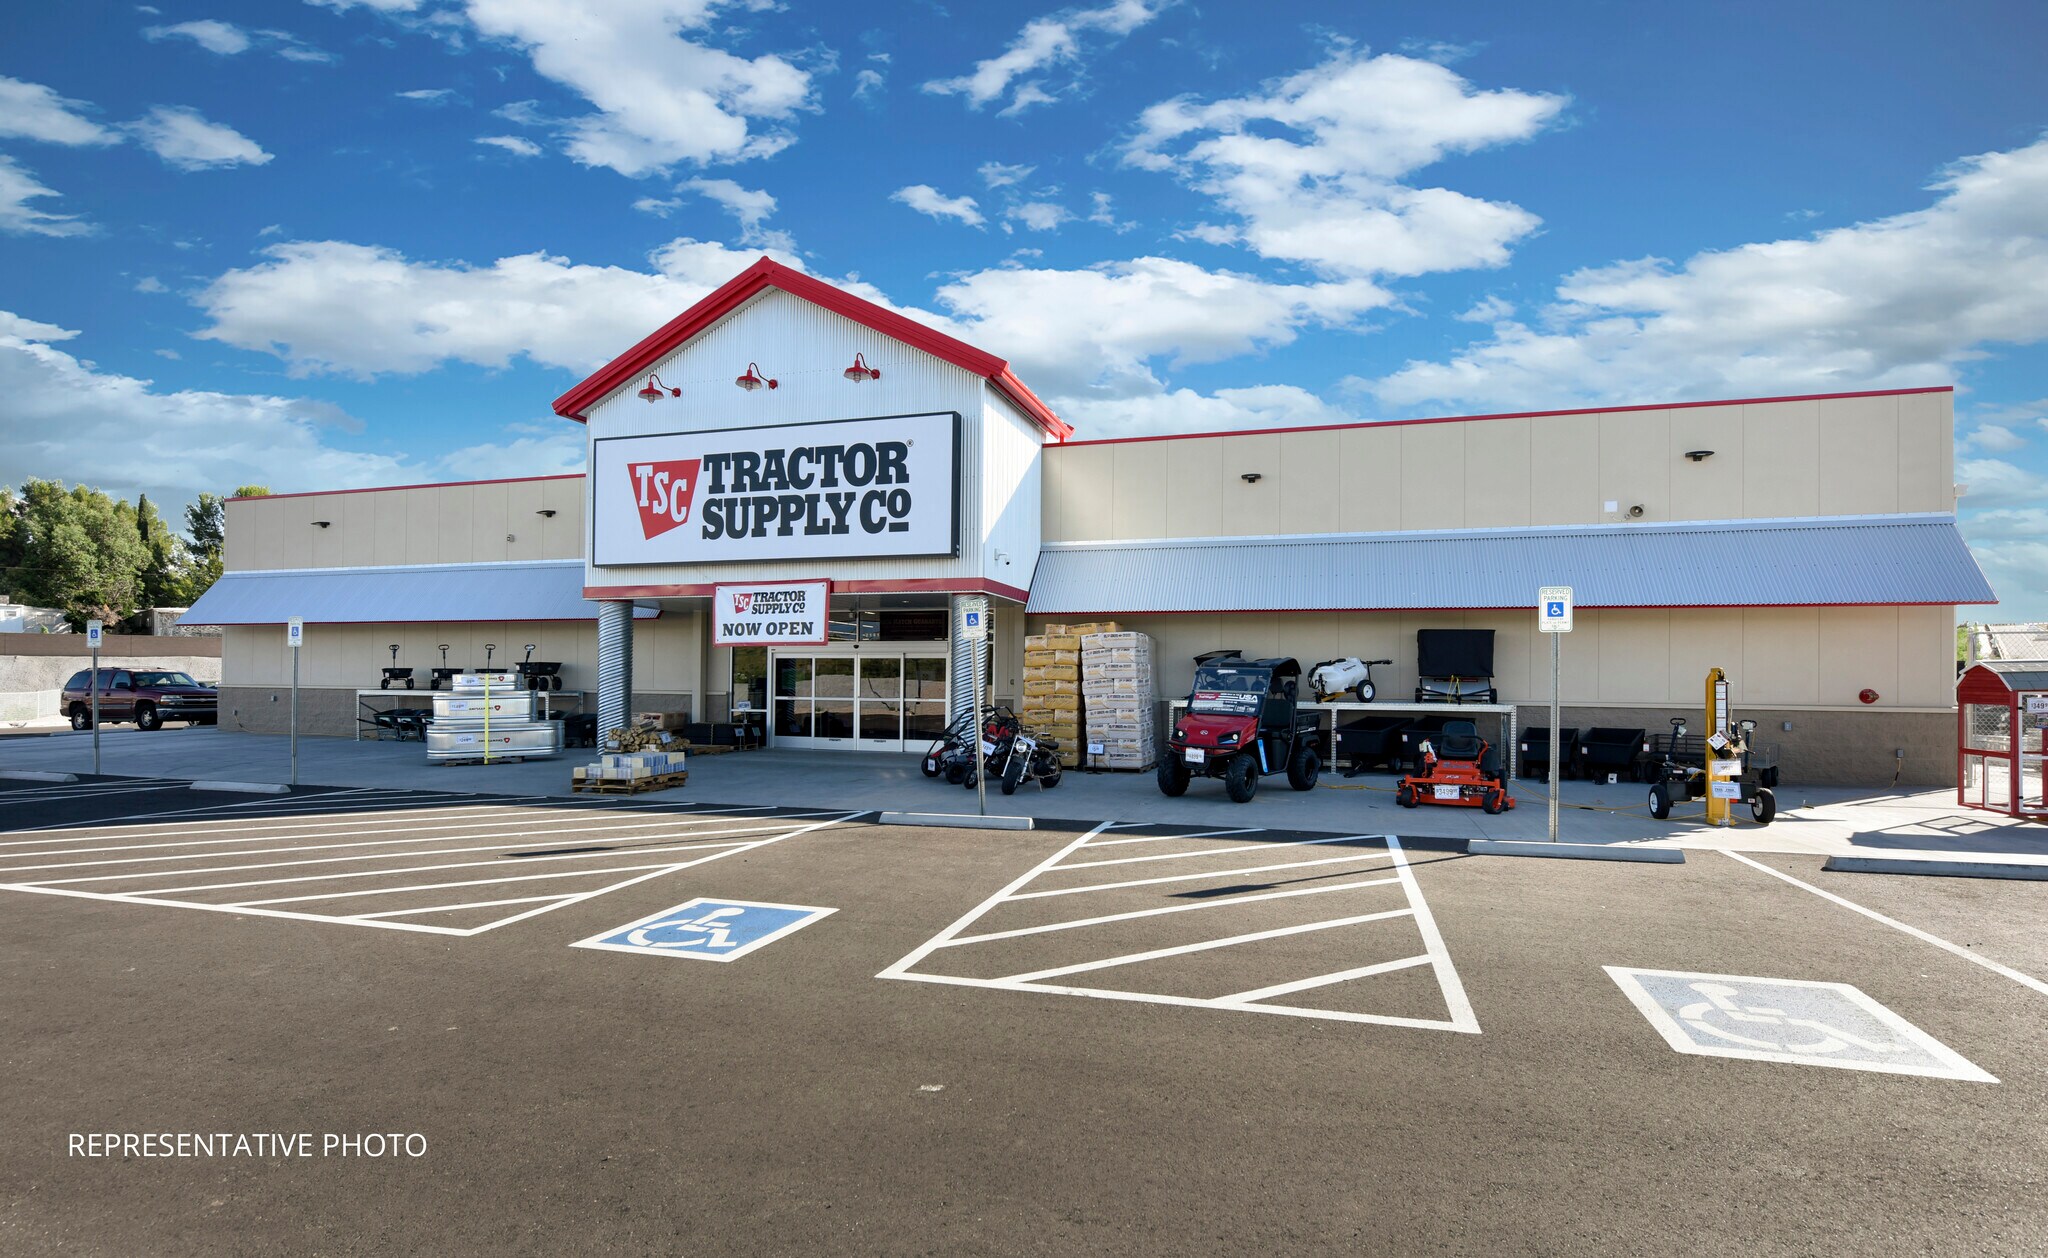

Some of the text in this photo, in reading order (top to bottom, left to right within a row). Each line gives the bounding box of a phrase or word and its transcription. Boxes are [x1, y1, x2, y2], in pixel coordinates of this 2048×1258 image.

[635, 464, 688, 523] TSC
[702, 493, 856, 540] SUPPLY
[734, 594, 749, 610] TSC
[752, 590, 806, 603] TRACTOR
[751, 603, 792, 615] SUPPLY
[722, 621, 814, 637] NOW OPEN
